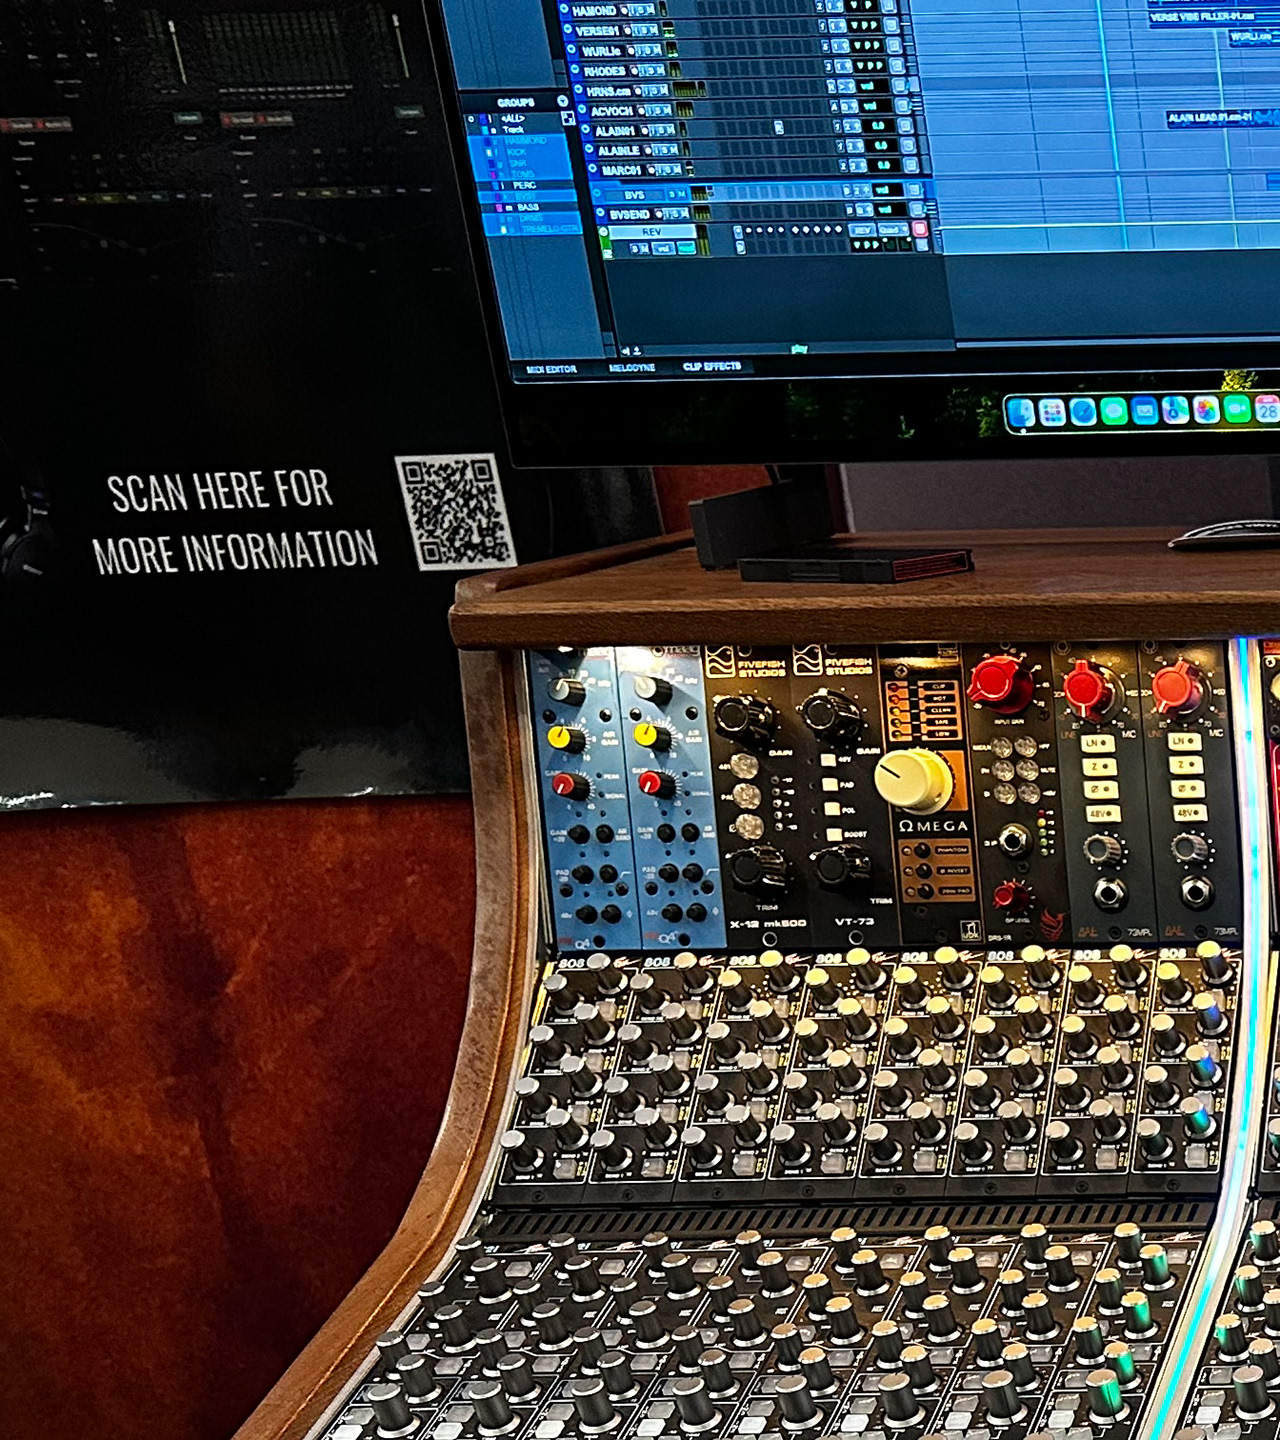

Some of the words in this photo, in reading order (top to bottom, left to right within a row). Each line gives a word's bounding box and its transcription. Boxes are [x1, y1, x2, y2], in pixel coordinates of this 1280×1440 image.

[584, 66, 626, 76] RHODES
[497, 97, 535, 108] GROUPS
[513, 181, 537, 190] PERC
[624, 191, 646, 200] BVS
[517, 203, 540, 212] BASS
[642, 228, 662, 237] REV
[546, 365, 578, 374] EDITOR
[609, 363, 656, 373] MELODYNE
[683, 361, 702, 372] CLIP
[703, 361, 742, 371] EFFECTS
[107, 474, 188, 513] SCAN
[192, 470, 270, 510] HERE
[273, 468, 334, 507] FOR
[92, 536, 178, 575] MORE
[182, 528, 379, 573] INFORMATION
[738, 660, 786, 668] FIVEFISH
[825, 658, 873, 666] FIVEFISH
[738, 669, 786, 678] STUDIOS
[825, 667, 873, 675] STUDIOS
[1086, 738, 1098, 747] LN
[1173, 737, 1185, 746] LN
[1090, 809, 1106, 818] 48V
[729, 920, 760, 929] X-12
[834, 917, 875, 926] VT-73
[558, 958, 586, 968] 808
